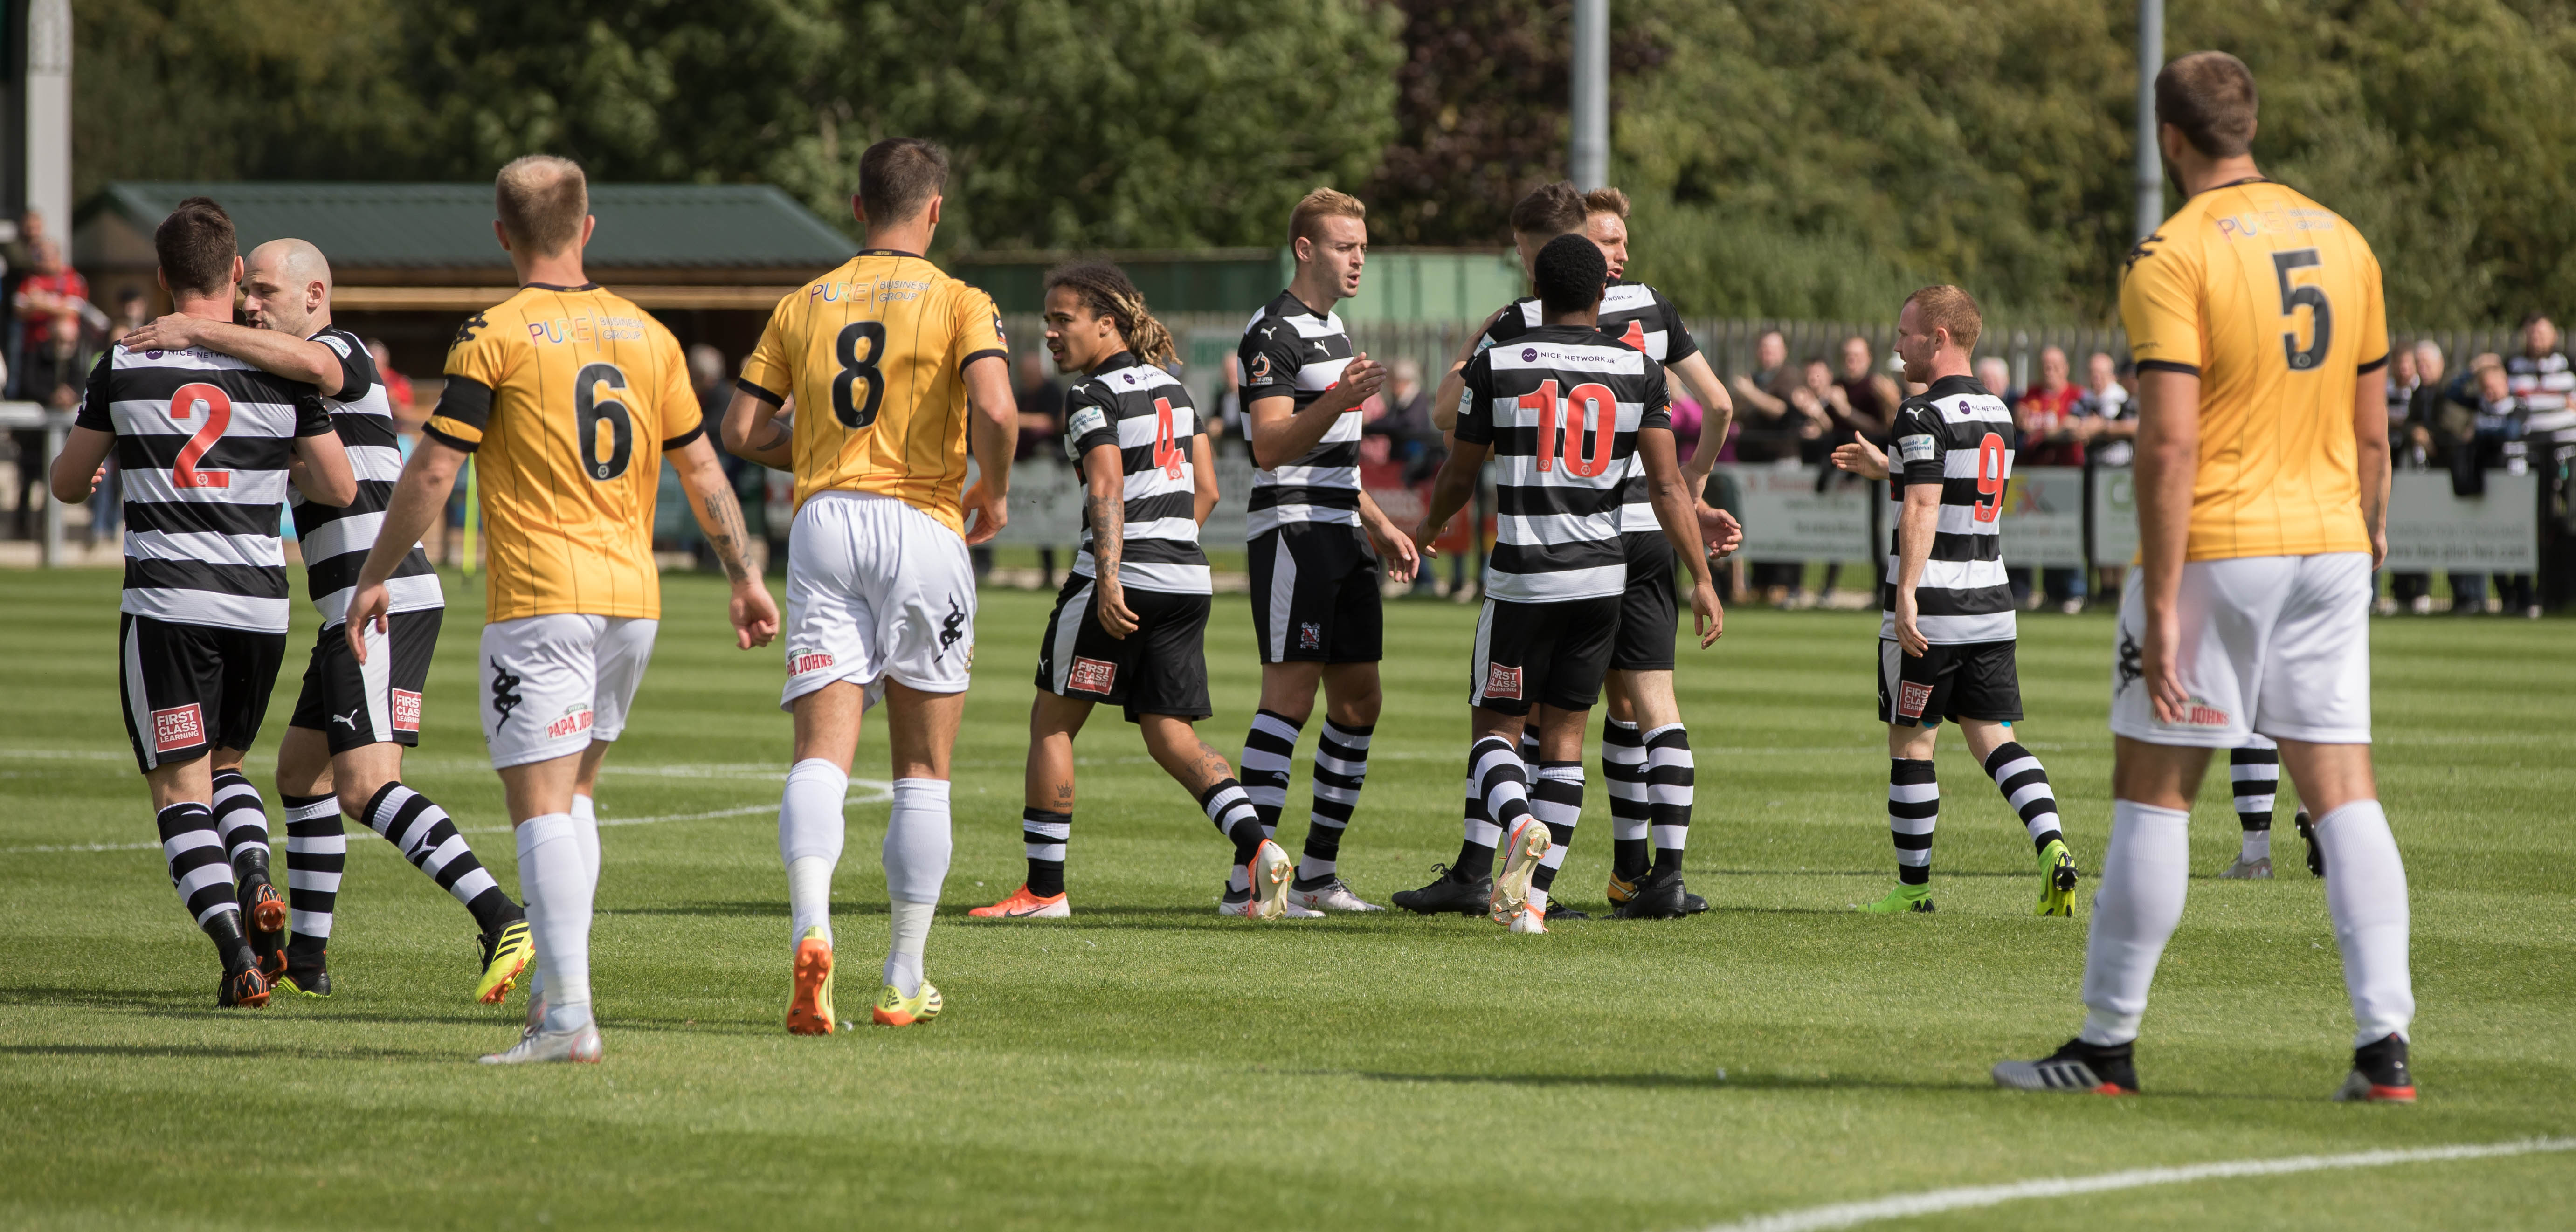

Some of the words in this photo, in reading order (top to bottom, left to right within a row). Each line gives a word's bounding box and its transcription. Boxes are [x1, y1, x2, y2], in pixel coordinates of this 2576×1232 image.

[880, 280, 931, 290] BUSINESS
[809, 282, 869, 305] PURE
[878, 291, 918, 302] GROUP
[2272, 248, 2334, 371] 5
[599, 317, 646, 329] BUSINESS
[528, 317, 590, 346] PURE
[602, 330, 642, 340] GROUP
[833, 320, 886, 429] 8
[575, 363, 633, 481] 6
[1518, 378, 1617, 477] 10
[170, 383, 232, 488] 2
[1153, 397, 1186, 481] 4
[1975, 432, 2005, 523] 9
[798, 654, 833, 674] JOHNS
[1078, 661, 1112, 675] FIRST
[1075, 677, 1107, 688] LEARNING
[1076, 670, 1109, 682] CLASS
[1904, 695, 1928, 706] CLAS
[1906, 686, 1932, 699] FIRS
[396, 706, 420, 718] CLAS
[1904, 703, 1925, 711] LEARN
[157, 709, 194, 727] FIRST
[2189, 706, 2230, 726] JOHNS
[159, 721, 198, 736] CLASS
[548, 716, 577, 739] PAPA
[160, 730, 199, 743] LEARNING
